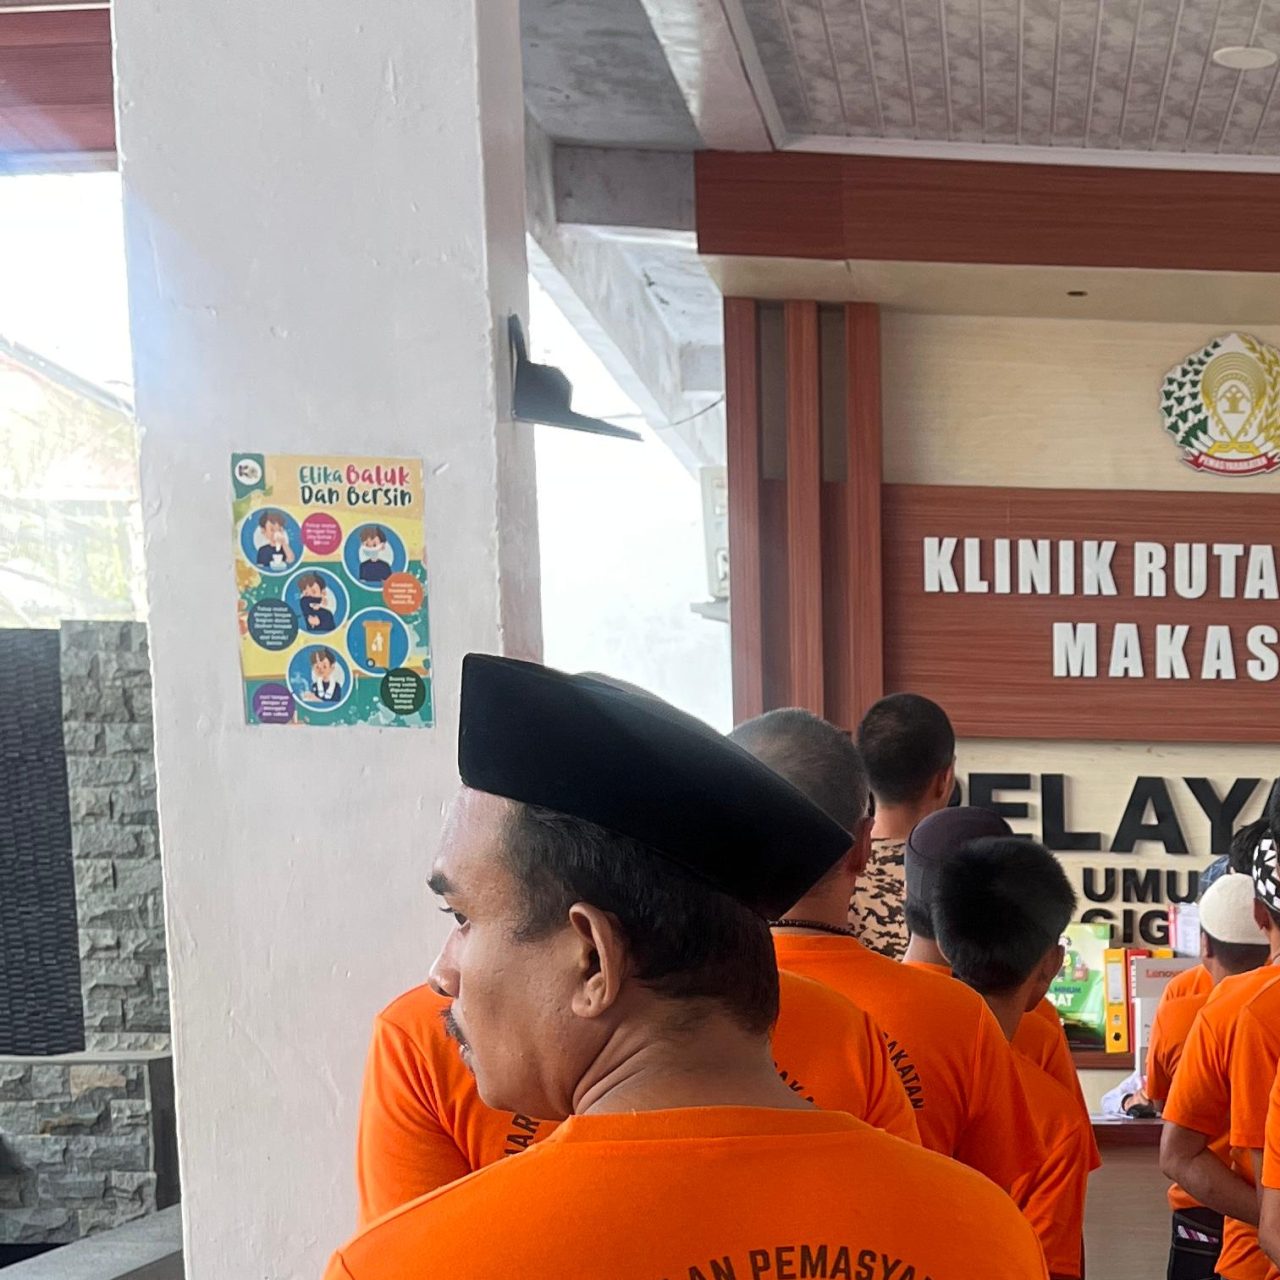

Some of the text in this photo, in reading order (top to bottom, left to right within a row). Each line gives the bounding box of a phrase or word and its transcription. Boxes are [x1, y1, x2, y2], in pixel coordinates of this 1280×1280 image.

[300, 485, 412, 506] Dan Bersin
[922, 536, 1118, 596] KLINIK
